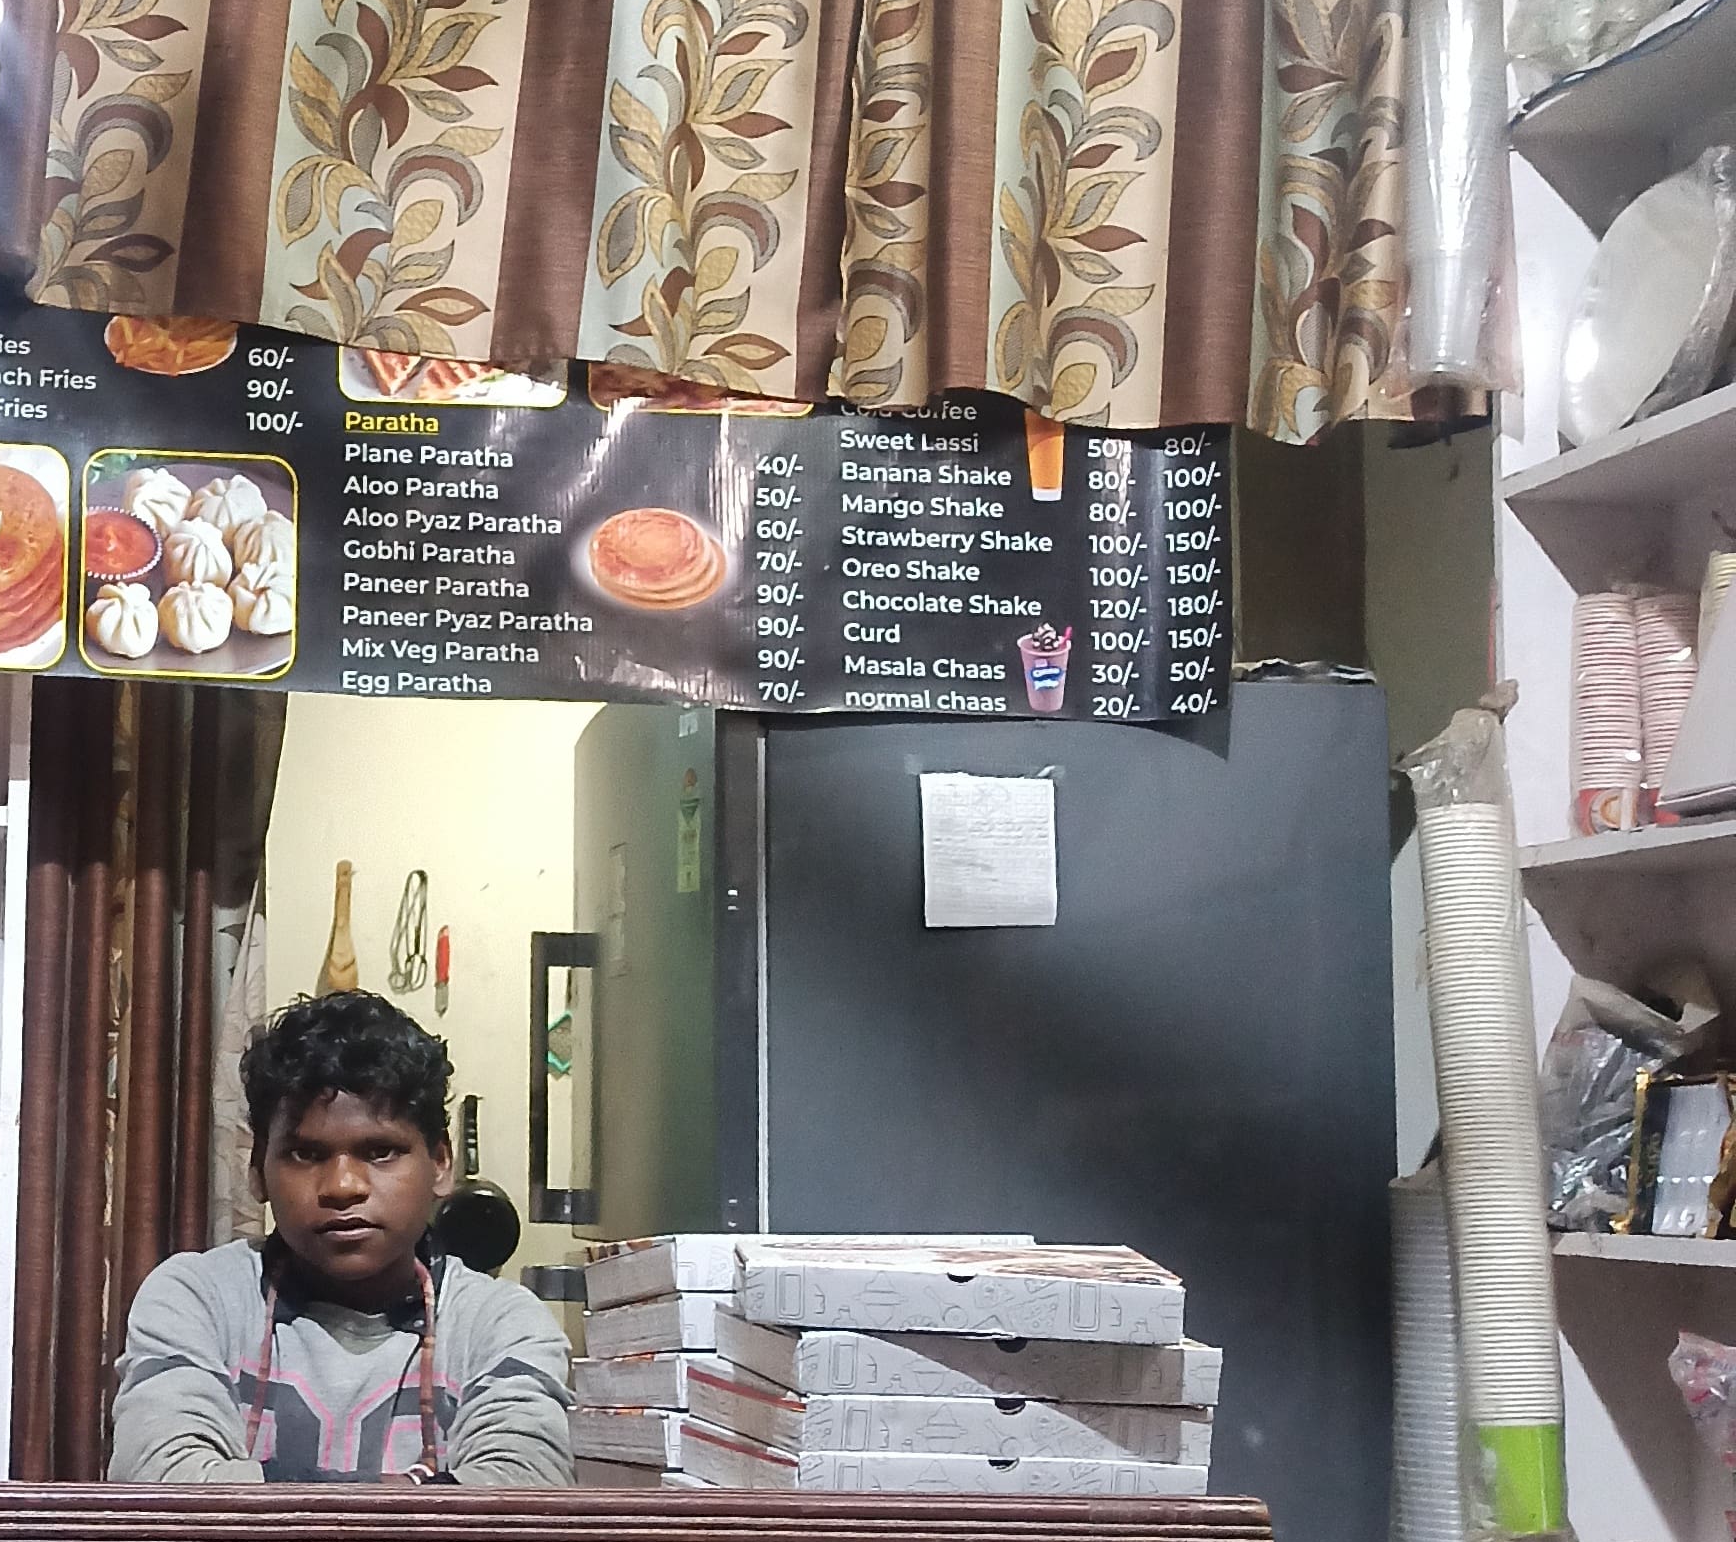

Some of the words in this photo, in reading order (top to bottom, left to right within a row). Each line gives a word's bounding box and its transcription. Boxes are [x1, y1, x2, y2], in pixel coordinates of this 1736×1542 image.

[248, 348, 294, 369] 60/-
[40, 370, 97, 390] Fries
[247, 380, 294, 401] 90/-
[246, 412, 302, 433] 100/-
[345, 412, 439, 433] Paratha
[840, 430, 915, 450] Sweet
[922, 433, 979, 452] Lassi
[1164, 433, 1211, 456] 80/-
[345, 445, 413, 464] Plane
[420, 447, 513, 468] Paratha
[756, 455, 803, 478] 40/-
[842, 462, 931, 483] Banana
[938, 466, 1011, 486] Shake
[1088, 468, 1135, 490] 80/-
[1164, 466, 1221, 488] 100/-
[344, 478, 398, 496] Aloo
[405, 479, 499, 500] Paratha
[756, 488, 802, 510] 50/-
[343, 510, 398, 529] Aloo
[406, 511, 461, 533] Pyaz
[468, 513, 562, 534] Paratha
[756, 521, 802, 543] 60/-
[842, 526, 974, 554] Strawberry
[980, 532, 1053, 551] Shake
[1089, 533, 1147, 555] 100/-
[1166, 526, 1221, 552] 150/-
[843, 591, 963, 613] Chocolate
[969, 596, 1041, 615] Shake
[1090, 598, 1147, 620] 120/-
[1168, 591, 1223, 617] 180/-
[342, 607, 428, 627] Paneer
[435, 610, 491, 632] Pyaz
[499, 611, 593, 632] Paratha
[758, 617, 804, 640] 90/-
[845, 656, 926, 677] Masala
[933, 659, 1006, 680] Chaas
[1092, 663, 1139, 686] 30/-
[1170, 657, 1215, 682] 50/-
[343, 673, 390, 694] Egg
[397, 674, 491, 694] Paratha
[759, 683, 805, 704] 70/-
[845, 689, 931, 710] normal
[937, 691, 1006, 712] chaas
[1093, 696, 1140, 717] 20/-
[1171, 689, 1217, 715] 40/-
